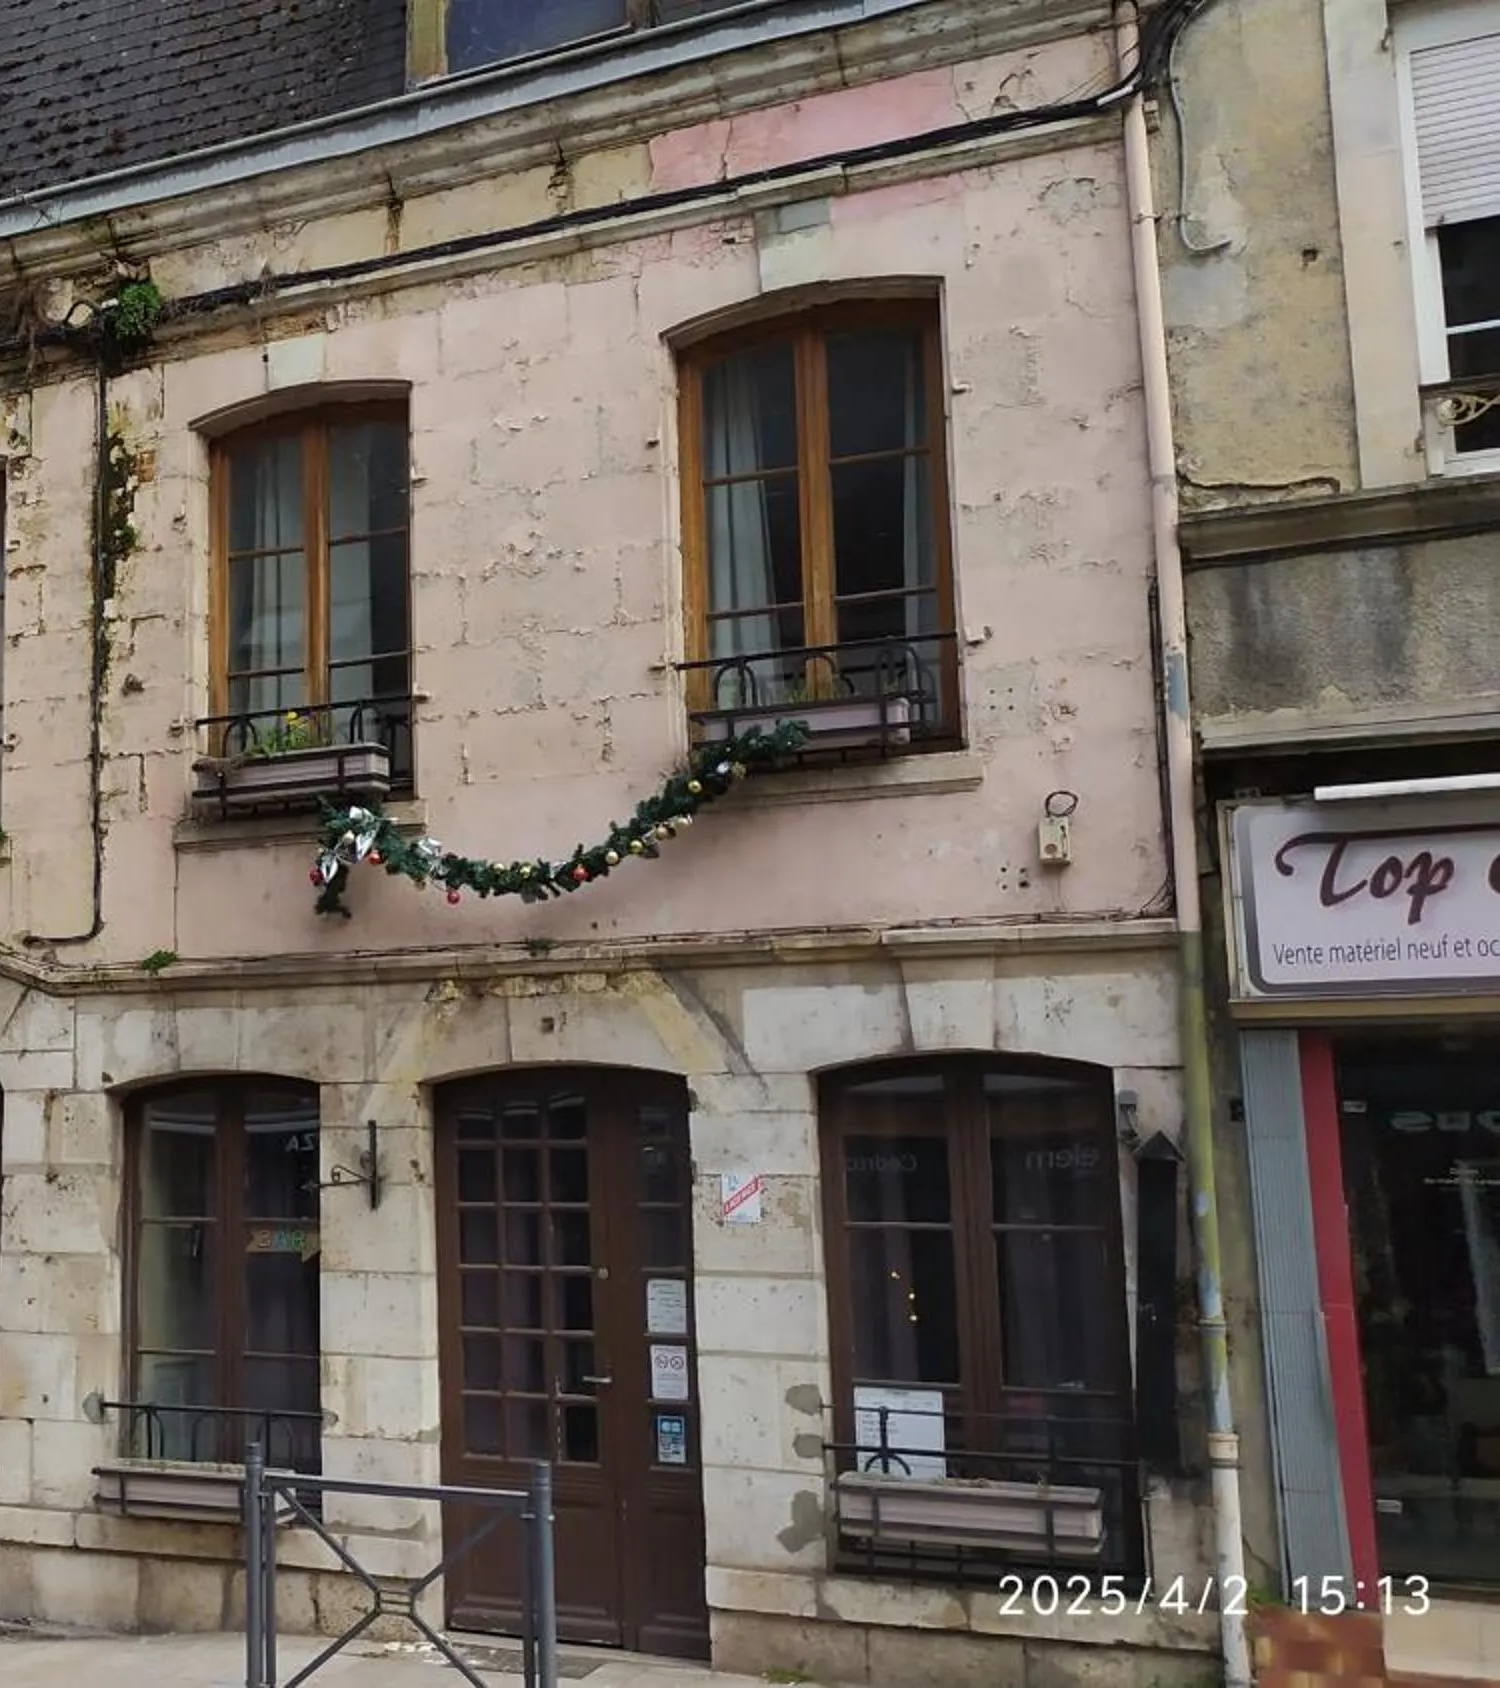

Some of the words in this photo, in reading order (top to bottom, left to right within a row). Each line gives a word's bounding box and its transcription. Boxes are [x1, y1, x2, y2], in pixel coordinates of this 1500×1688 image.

[1275, 826, 1456, 925] Top
[1273, 943, 1323, 965] Vente
[1329, 938, 1401, 963] matériel
[1407, 934, 1448, 960] neuf
[1454, 939, 1473, 957] et
